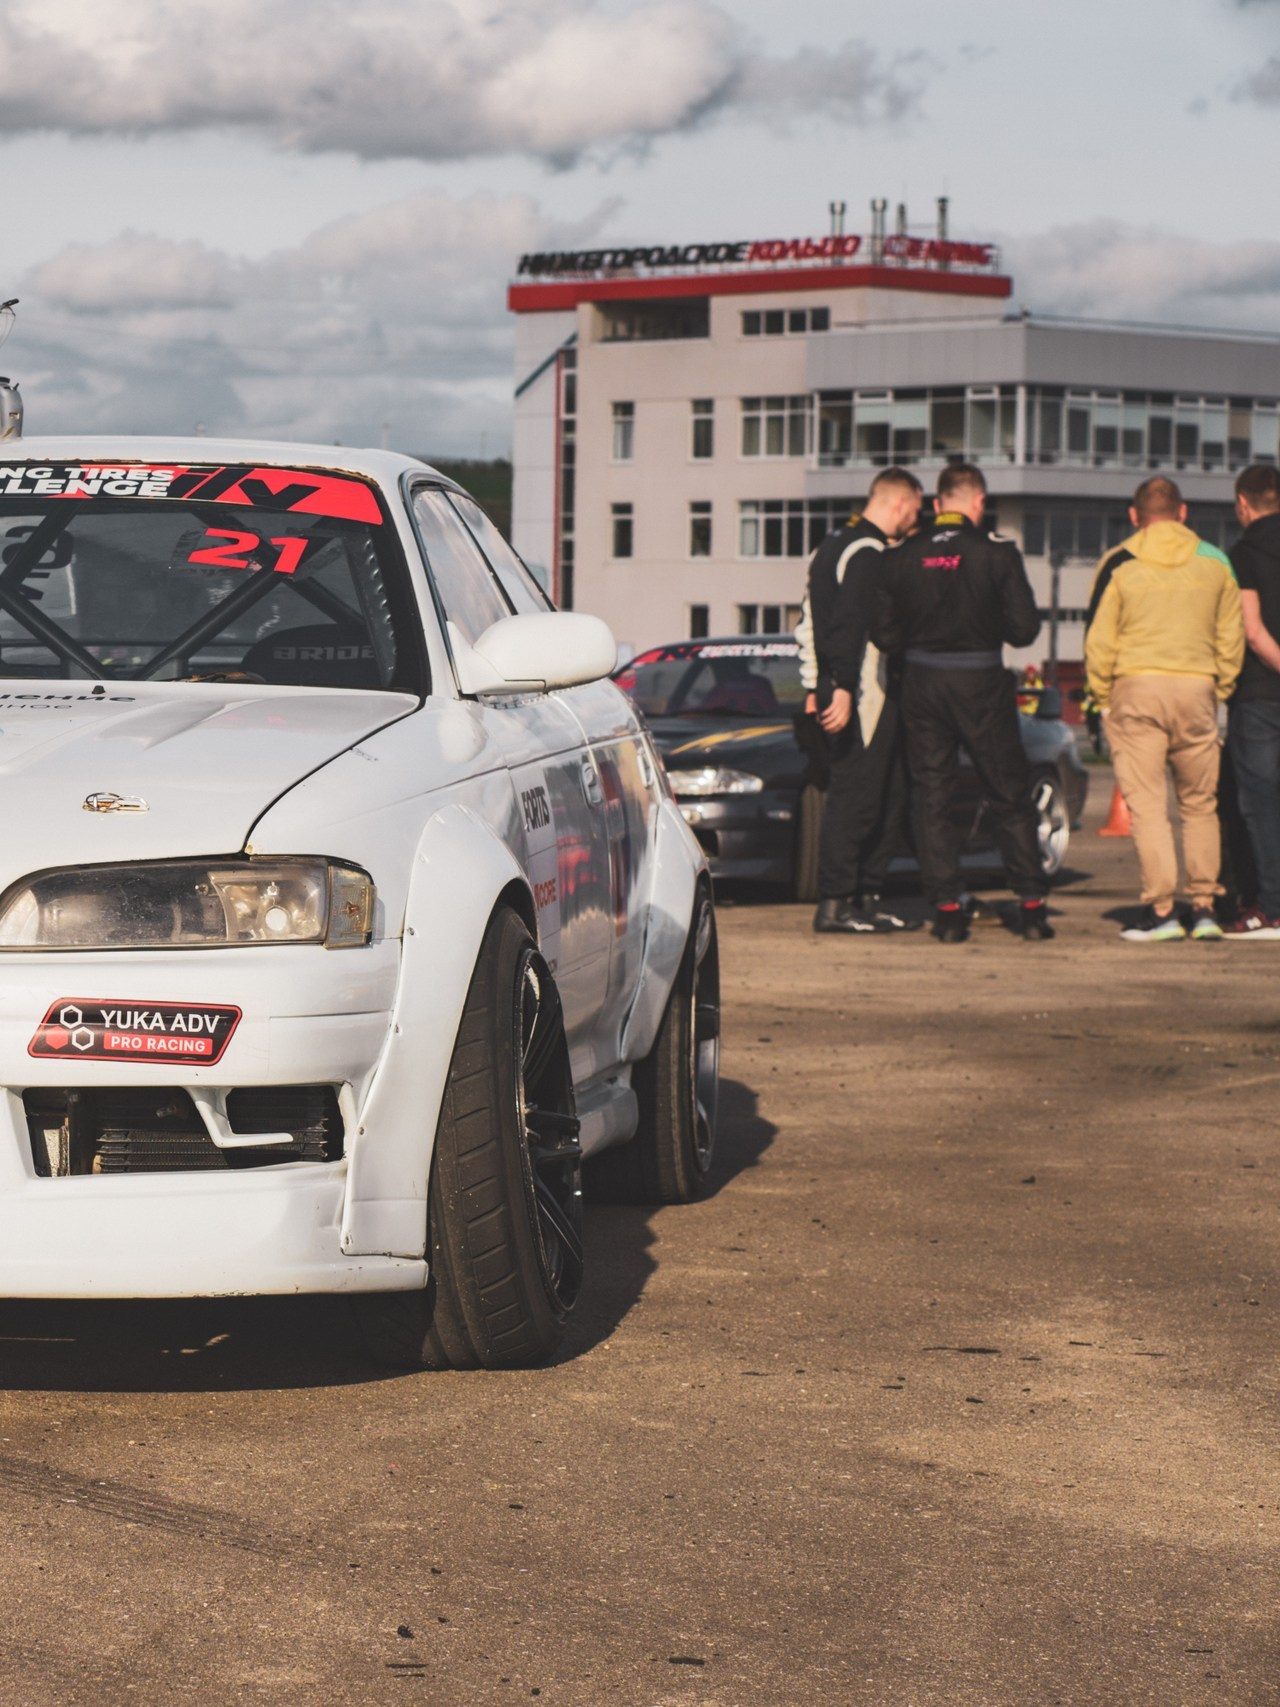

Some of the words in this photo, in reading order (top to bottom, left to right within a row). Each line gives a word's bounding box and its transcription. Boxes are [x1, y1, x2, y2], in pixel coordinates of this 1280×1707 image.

[64, 466, 175, 482] TIRES
[187, 527, 309, 574] 21
[272, 645, 375, 661] BRIDE
[521, 786, 551, 832] FORTIS
[100, 1009, 166, 1031] YUKA
[170, 1013, 220, 1034] ADV
[111, 1036, 142, 1049] PRO
[146, 1038, 206, 1052] RACING
